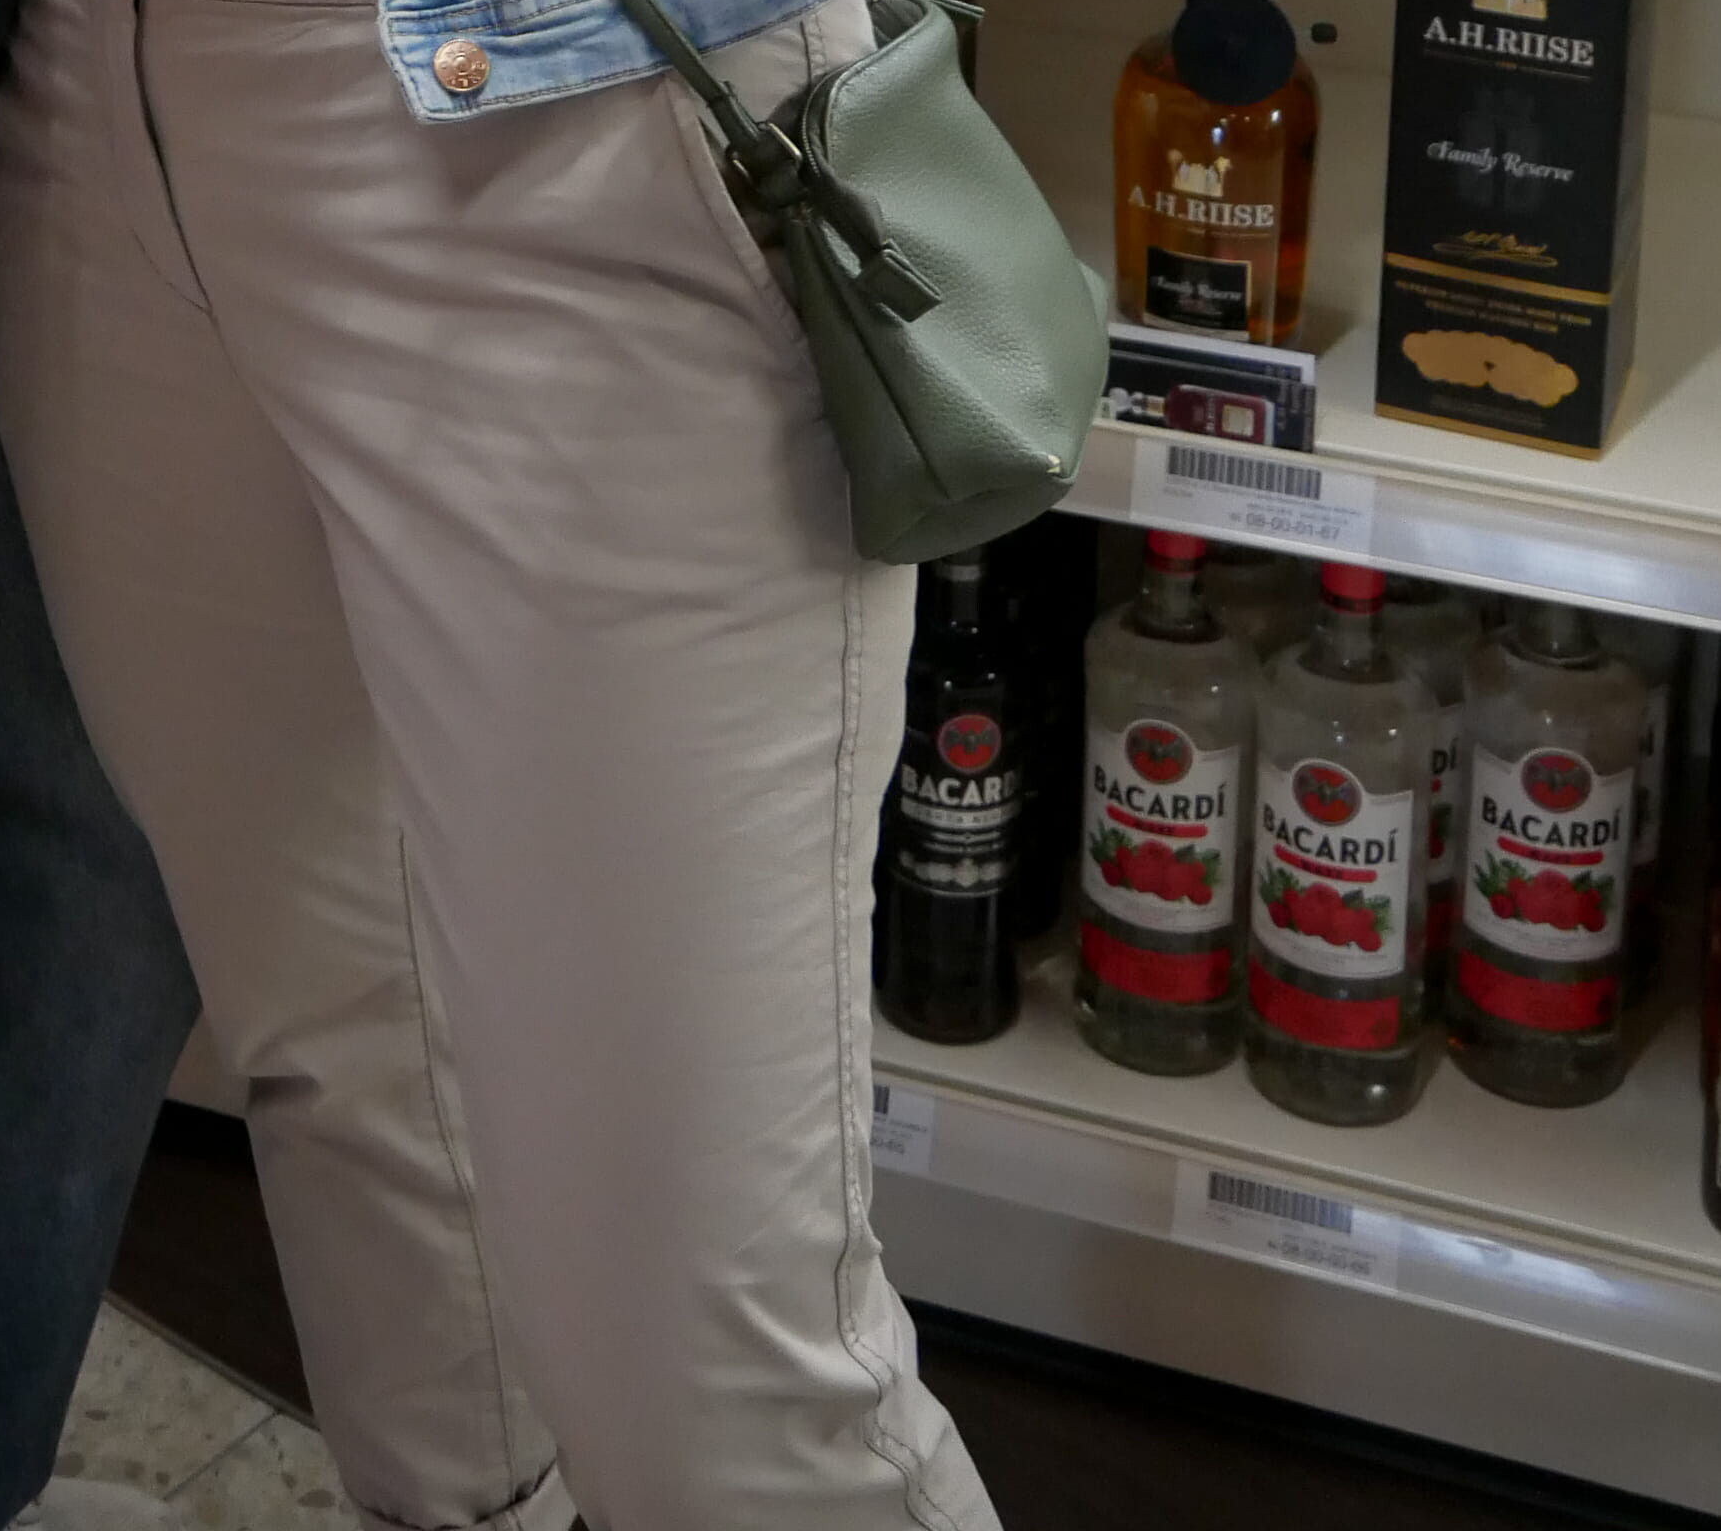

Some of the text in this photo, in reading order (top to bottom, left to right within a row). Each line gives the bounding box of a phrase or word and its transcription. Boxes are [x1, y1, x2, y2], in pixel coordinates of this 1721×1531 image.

[1423, 16, 1595, 67] A.H.RIISE
[1427, 140, 1575, 182] Family Reserve
[1093, 764, 1227, 820] BACARDÍ
[1263, 803, 1399, 865] BACARDÍ
[1482, 794, 1622, 848] BACARDÍ
